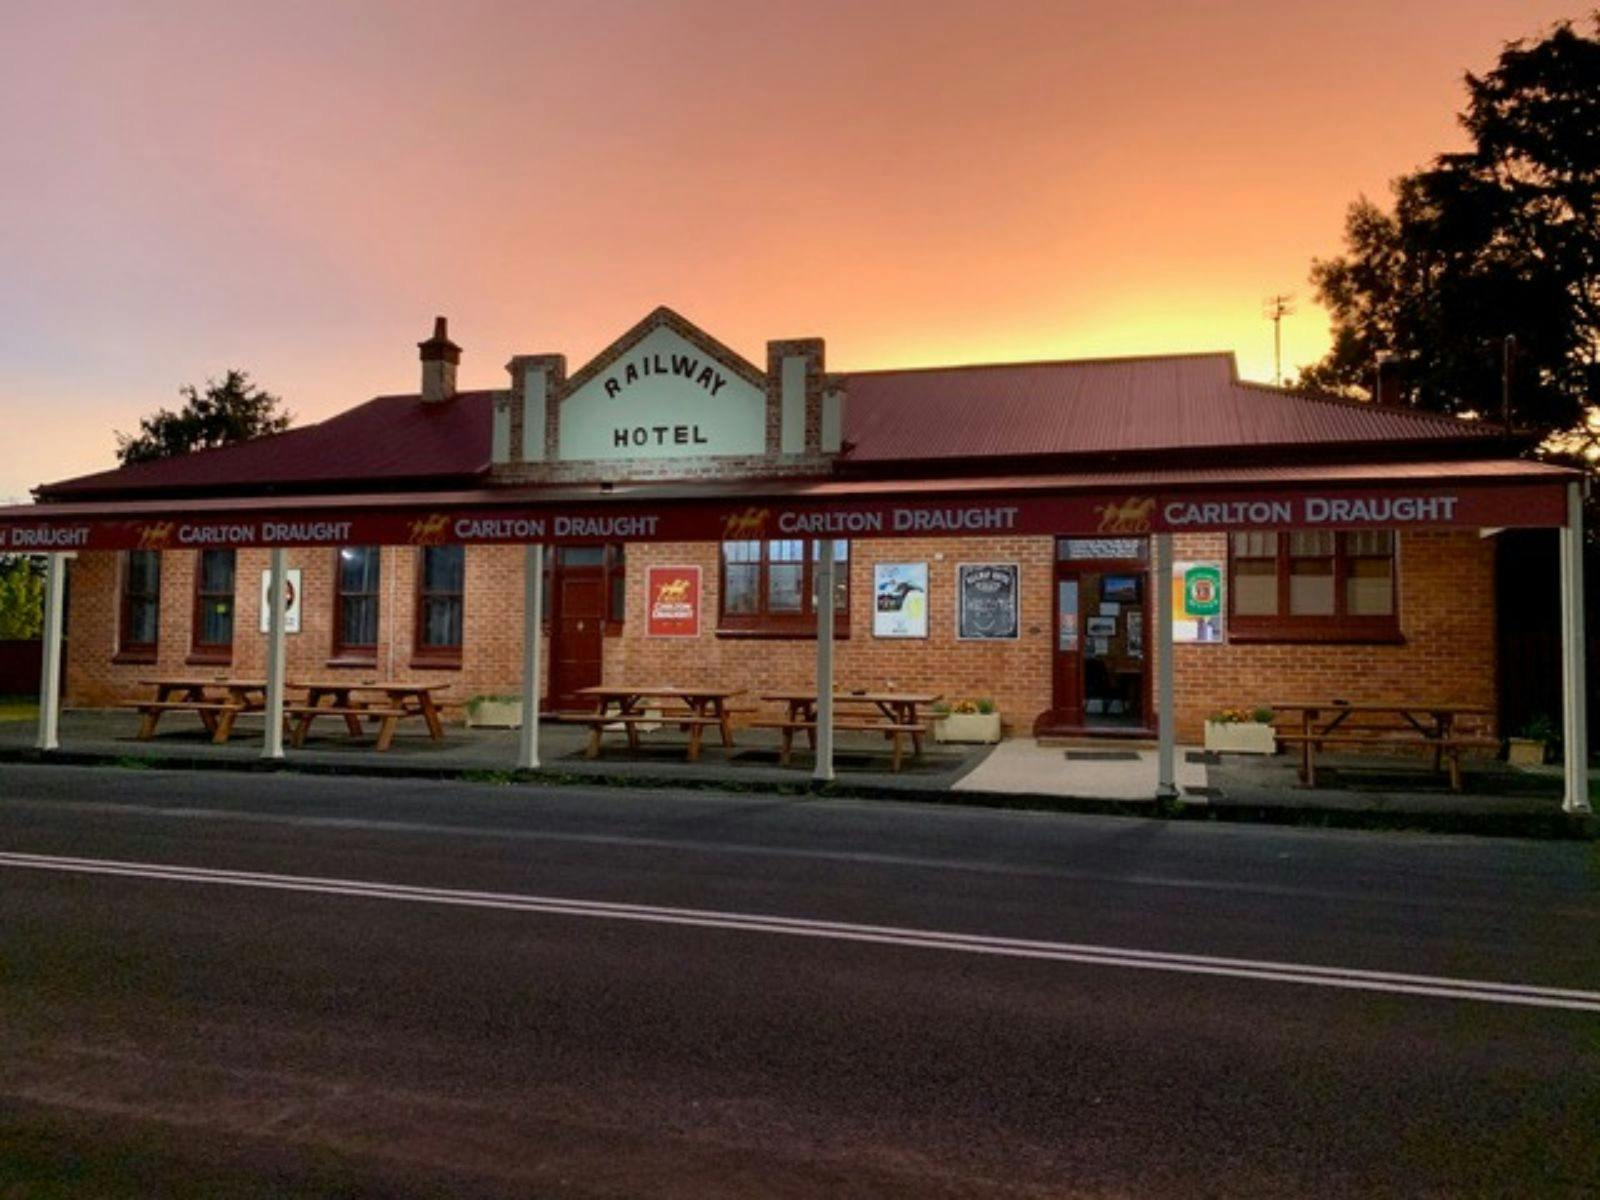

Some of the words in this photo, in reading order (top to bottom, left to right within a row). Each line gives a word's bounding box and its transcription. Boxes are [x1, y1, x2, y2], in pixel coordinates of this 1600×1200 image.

[604, 354, 727, 399] RAILWAY
[614, 425, 708, 447] HOTEL
[778, 512, 882, 533] CARLTON
[893, 507, 1018, 530] DRAUGHT
[1164, 502, 1291, 525] CARLTON
[1305, 497, 1458, 523] DRAUGHT
[12, 527, 90, 546] DRAUGHT
[178, 525, 254, 543] CARLTON
[262, 522, 352, 541] DRAUGHT
[454, 519, 545, 538] CARLTON
[554, 517, 658, 537] DRAUGHT
